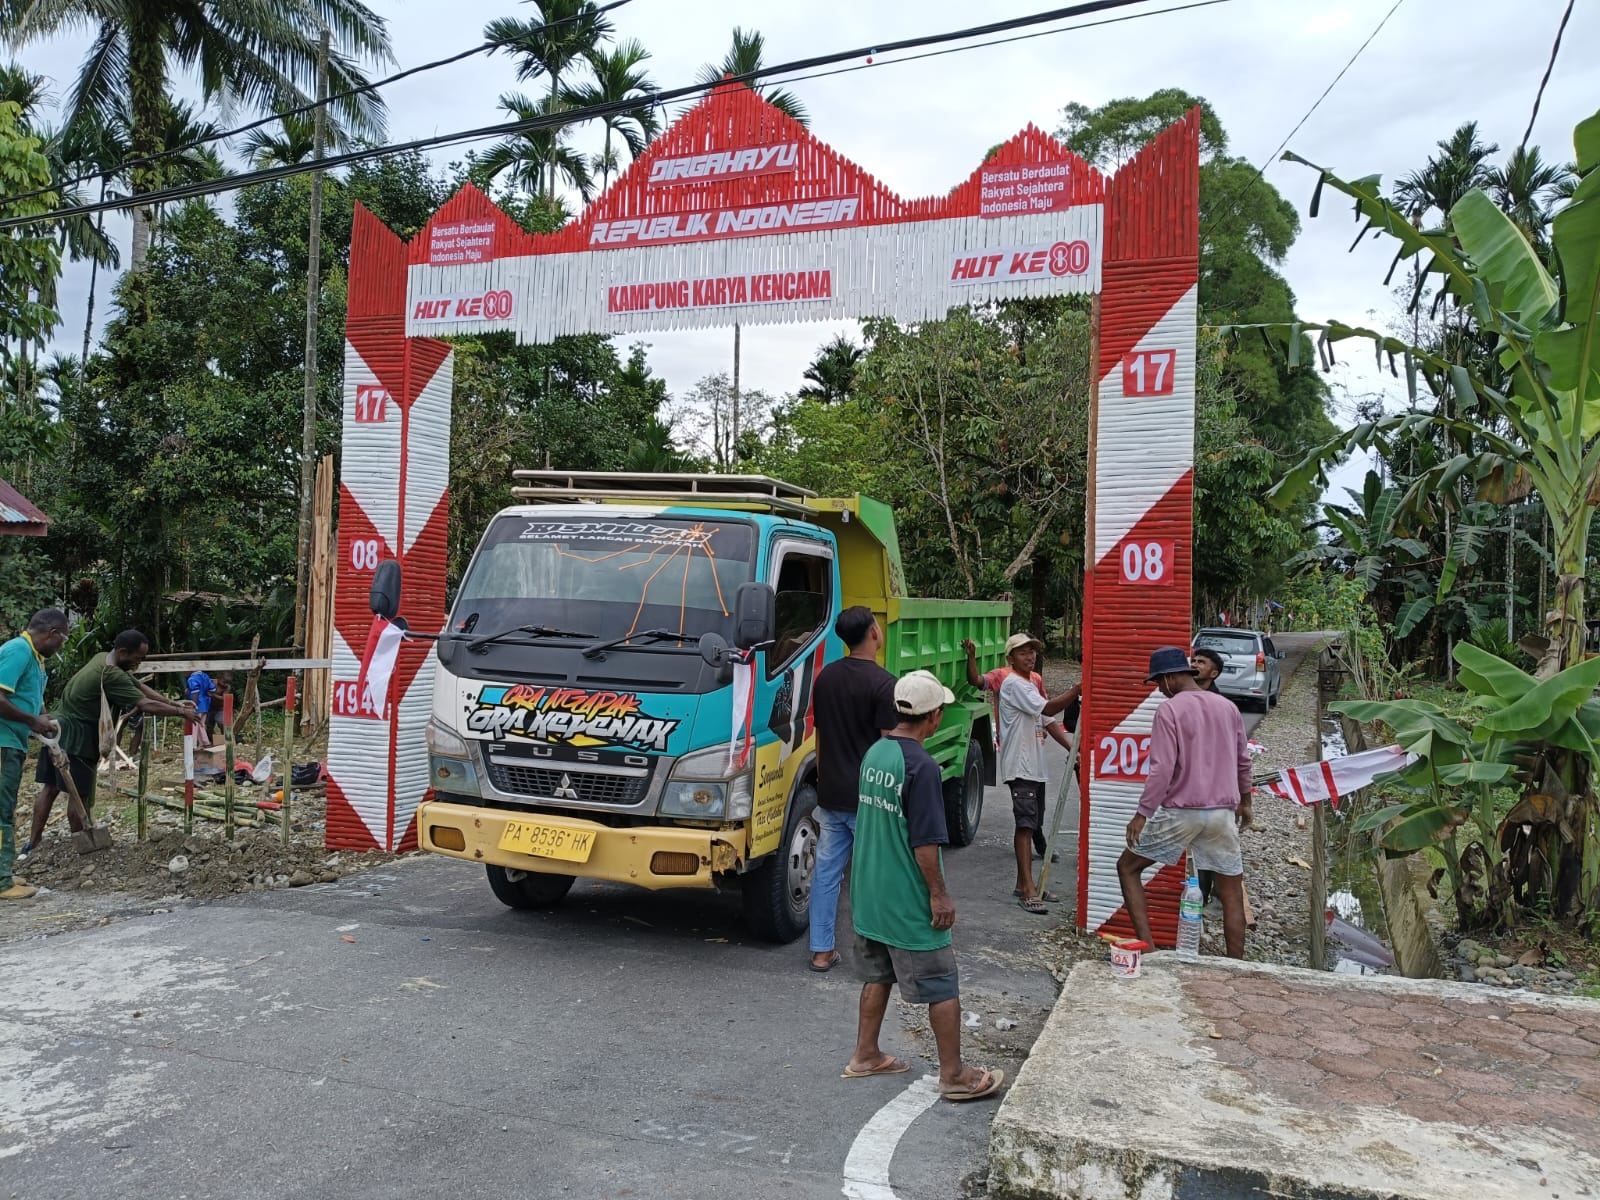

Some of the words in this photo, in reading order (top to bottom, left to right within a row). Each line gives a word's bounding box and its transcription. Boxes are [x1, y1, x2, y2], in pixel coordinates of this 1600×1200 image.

[649, 144, 798, 182] DIRGAHAYU
[981, 169, 1020, 183] Bersatu
[1022, 164, 1070, 178] Berdaulat
[981, 185, 1015, 200] Rakyat
[1017, 181, 1064, 197] Sejahtera
[981, 199, 1028, 214] Indonesia
[1030, 197, 1053, 212] Maju
[432, 225, 459, 237] Bersatu
[461, 222, 495, 235] Berdaulat
[590, 213, 711, 244] REPUBLIK
[715, 198, 859, 232] INDONESIA
[430, 252, 464, 264] Indonesia
[465, 249, 482, 262] Maju
[431, 239, 455, 251] Rakyat
[456, 236, 490, 249] Sejahtera
[951, 255, 1003, 281] HUT
[1009, 251, 1047, 275] KE
[608, 280, 689, 312] KAMPUNG
[692, 276, 747, 306] KARYA
[750, 270, 831, 300] KENCANA
[413, 299, 451, 320] HUT
[455, 297, 483, 317] KE
[1129, 353, 1171, 393] 17
[359, 389, 384, 420] 17
[580, 535, 633, 543] LANCAR
[352, 539, 379, 570] 08
[1123, 542, 1164, 582] 08
[335, 683, 373, 714] 194
[489, 744, 648, 766] FUSO
[1100, 736, 1151, 775] 202
[504, 823, 522, 841] PA
[530, 826, 566, 847] 8536
[571, 833, 591, 851] HK
